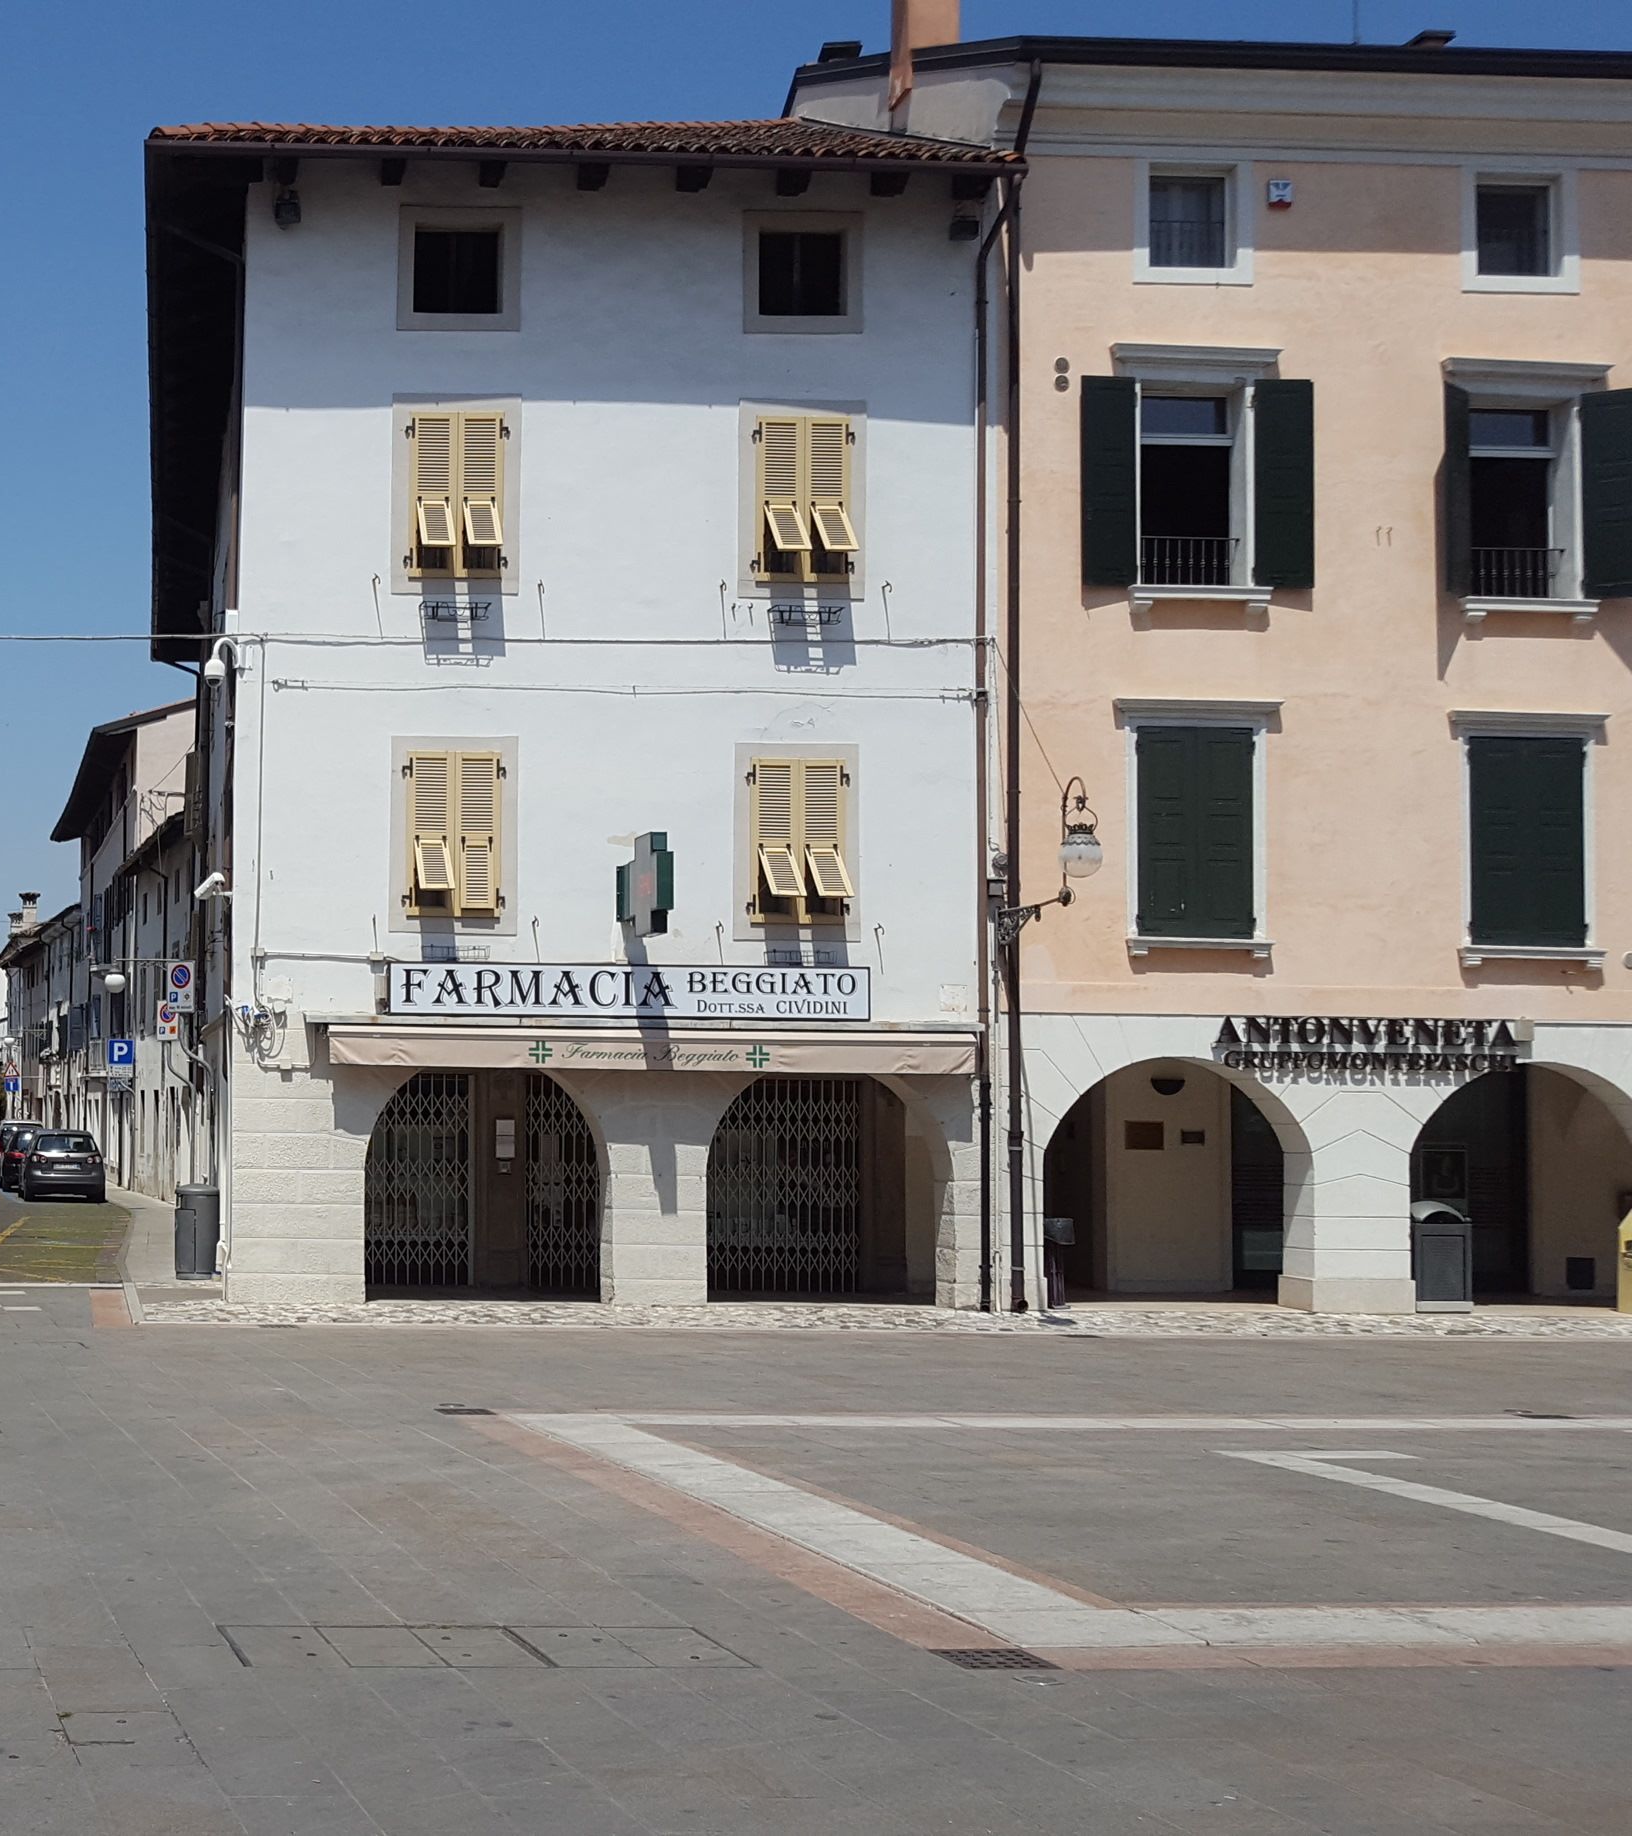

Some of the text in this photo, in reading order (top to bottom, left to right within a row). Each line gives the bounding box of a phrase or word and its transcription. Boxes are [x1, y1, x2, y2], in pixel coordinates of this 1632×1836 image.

[399, 968, 858, 1011] FARMACIA BEGGIATO
[775, 999, 850, 1016] CIVIDINI
[1214, 1015, 1517, 1047] ANTONVENETA
[113, 1042, 128, 1062] P
[561, 1042, 740, 1067] Farmacia Beggiato
